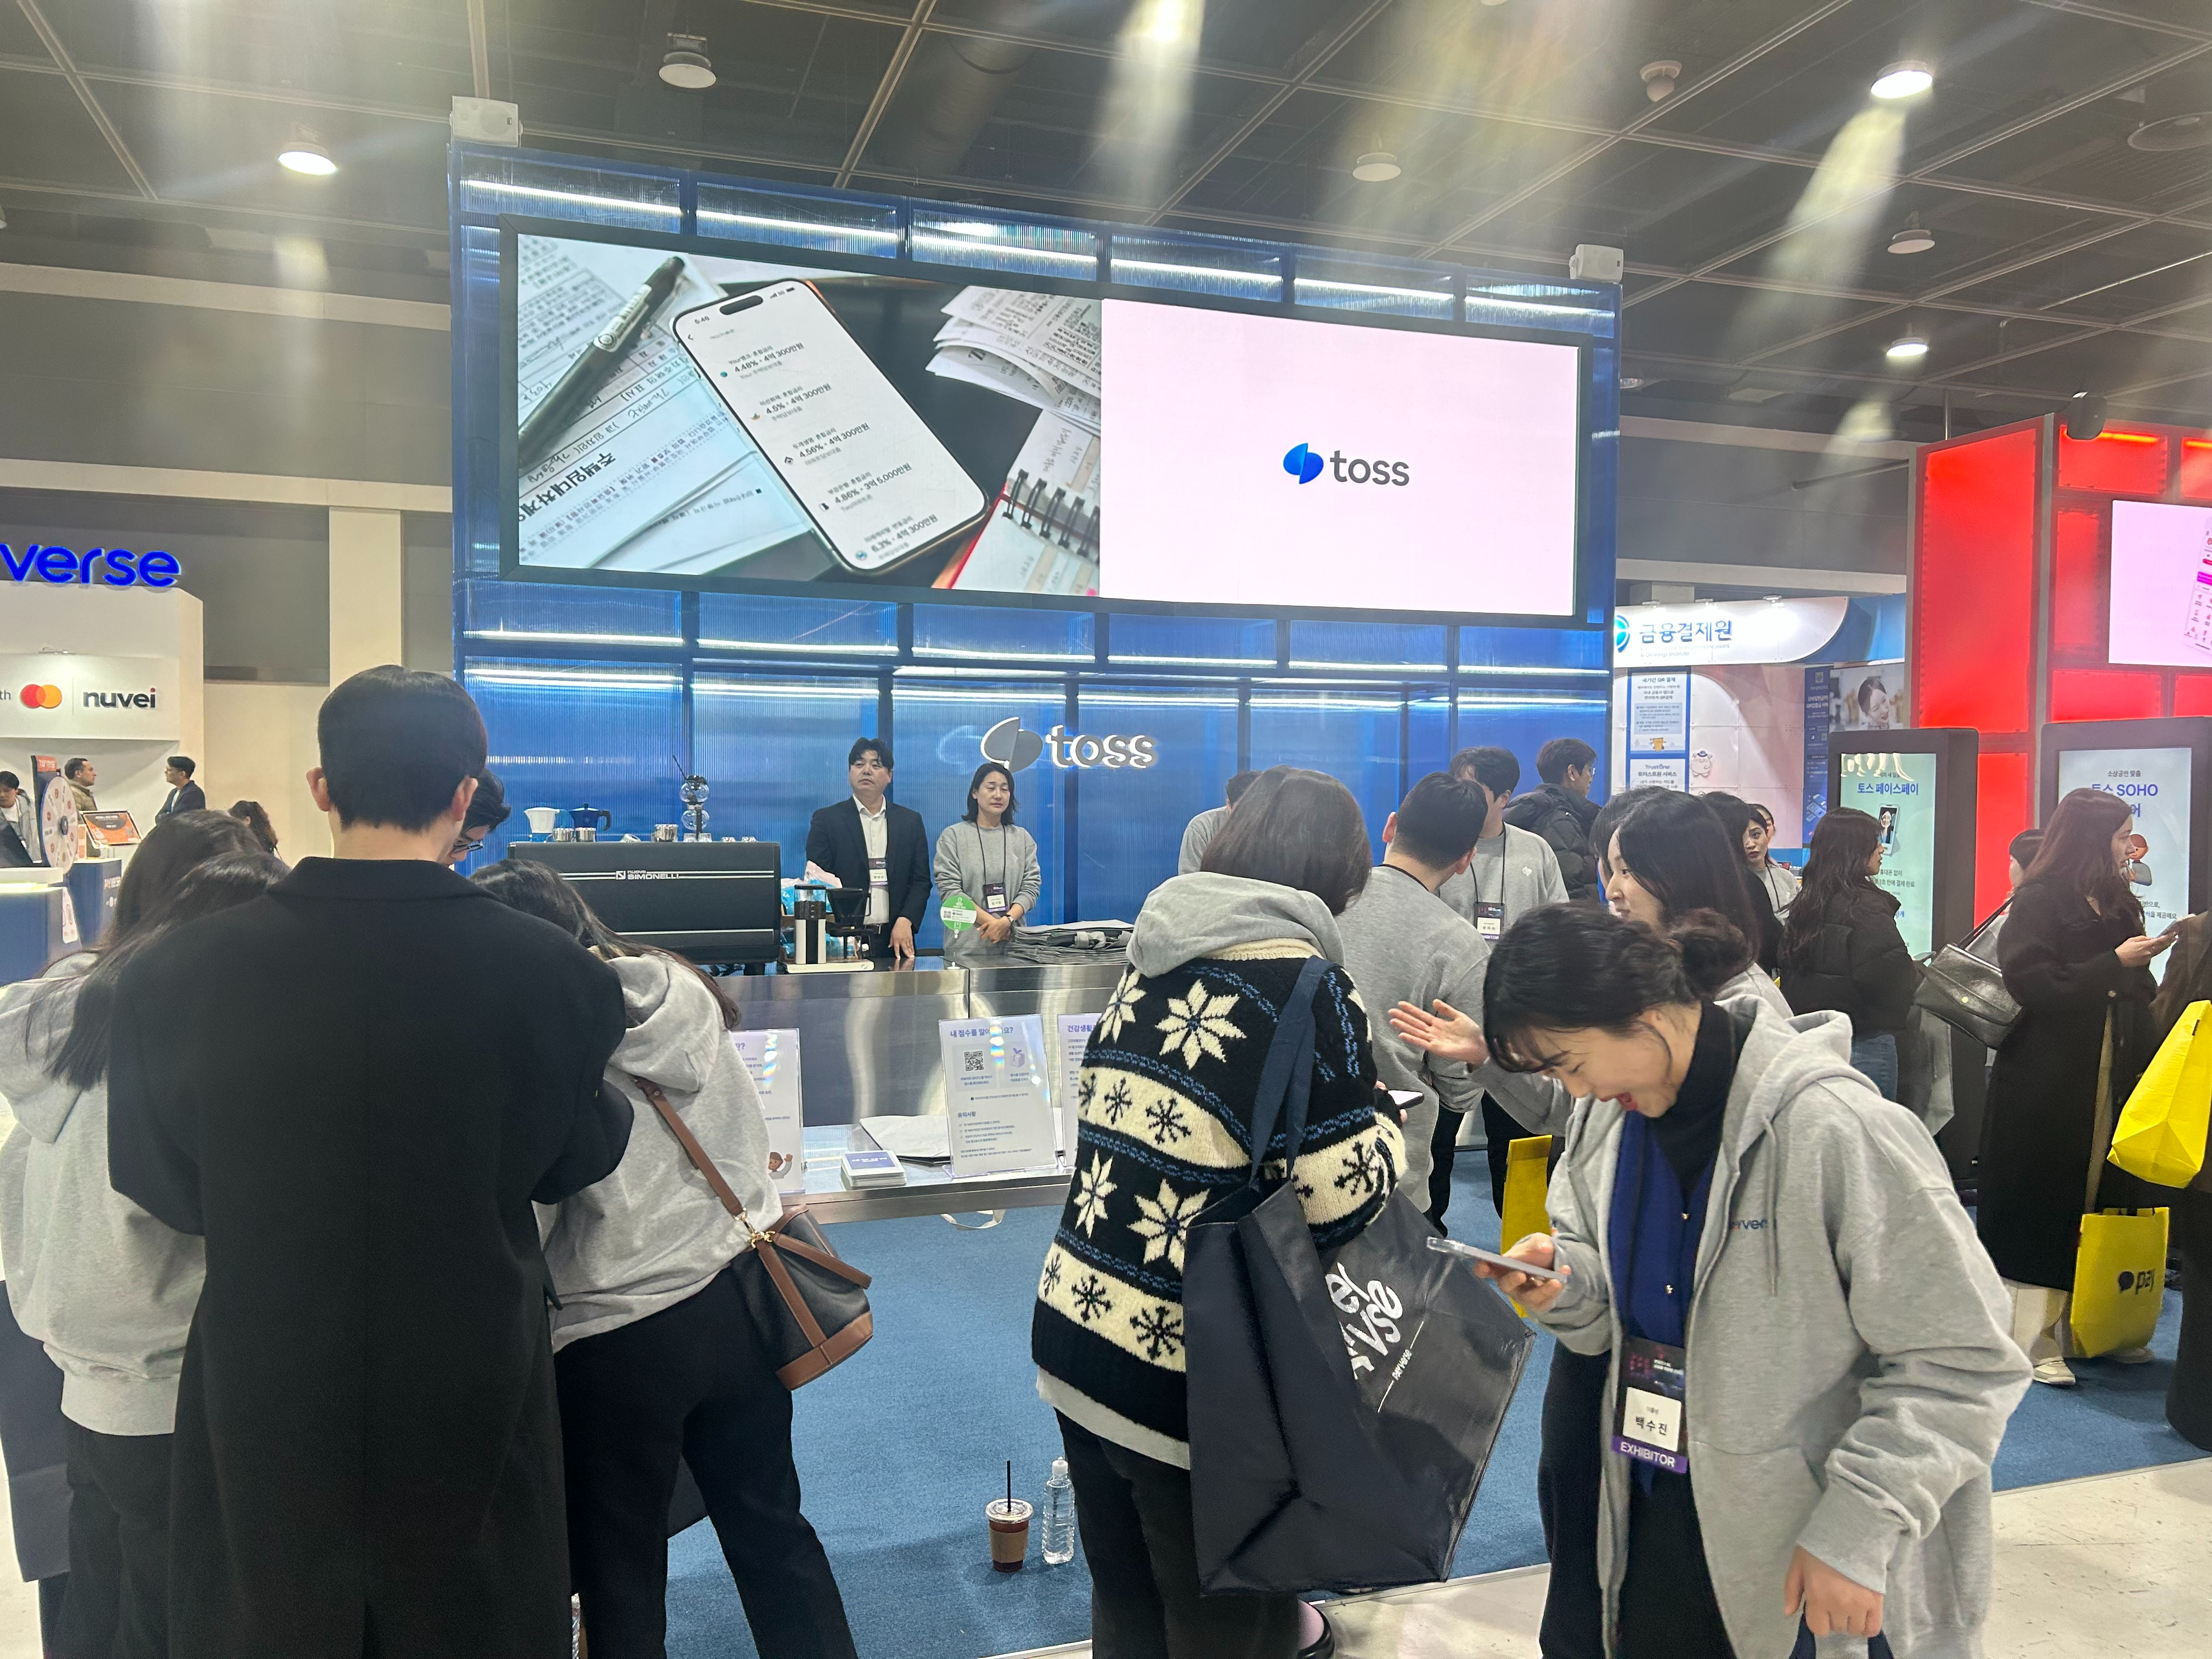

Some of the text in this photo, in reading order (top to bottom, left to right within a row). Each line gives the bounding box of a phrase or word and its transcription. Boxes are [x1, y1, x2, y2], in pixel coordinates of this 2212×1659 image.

[764, 353, 776, 362] 4억
[776, 342, 804, 358] 300만원
[791, 396, 804, 404] 4억
[803, 383, 832, 399] 300만원
[799, 422, 870, 458] 4.56% 4억 300만원
[1330, 450, 1409, 486] toss
[1639, 620, 1733, 644] 금융결제원
[82, 687, 156, 709] nuvei
[1045, 725, 1158, 768] toss
[1858, 782, 1918, 795] 토스 페이스페이
[2116, 784, 2158, 796] SOHO
[958, 1029, 977, 1037] 점수를
[1067, 1024, 1096, 1032] 건강생활
[1635, 1415, 1667, 1435] 백수진
[1620, 1442, 1675, 1467] EXHIBITOR
